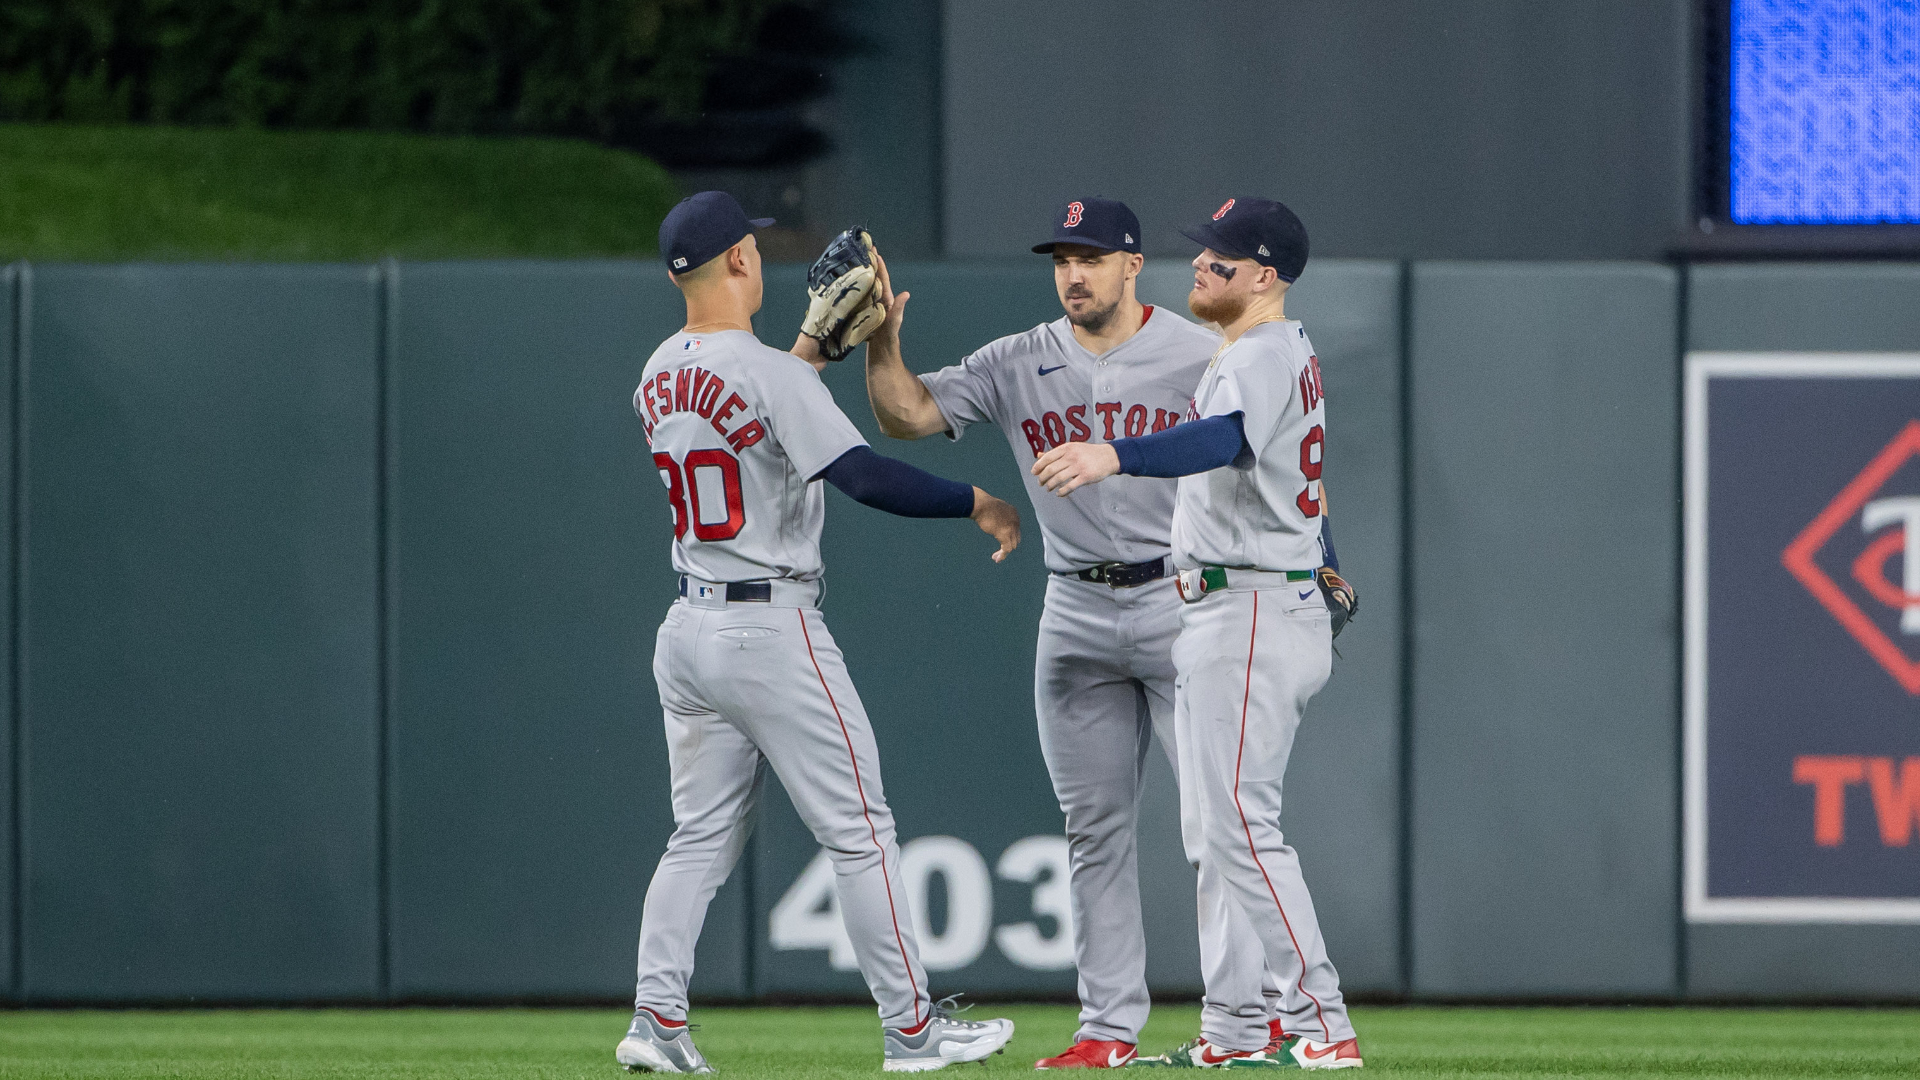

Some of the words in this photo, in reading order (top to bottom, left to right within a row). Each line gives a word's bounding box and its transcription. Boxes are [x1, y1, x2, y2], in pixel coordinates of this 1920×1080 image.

[1064, 201, 1084, 228] B
[1021, 401, 1180, 458] BOSTON
[769, 835, 1076, 971] 403
